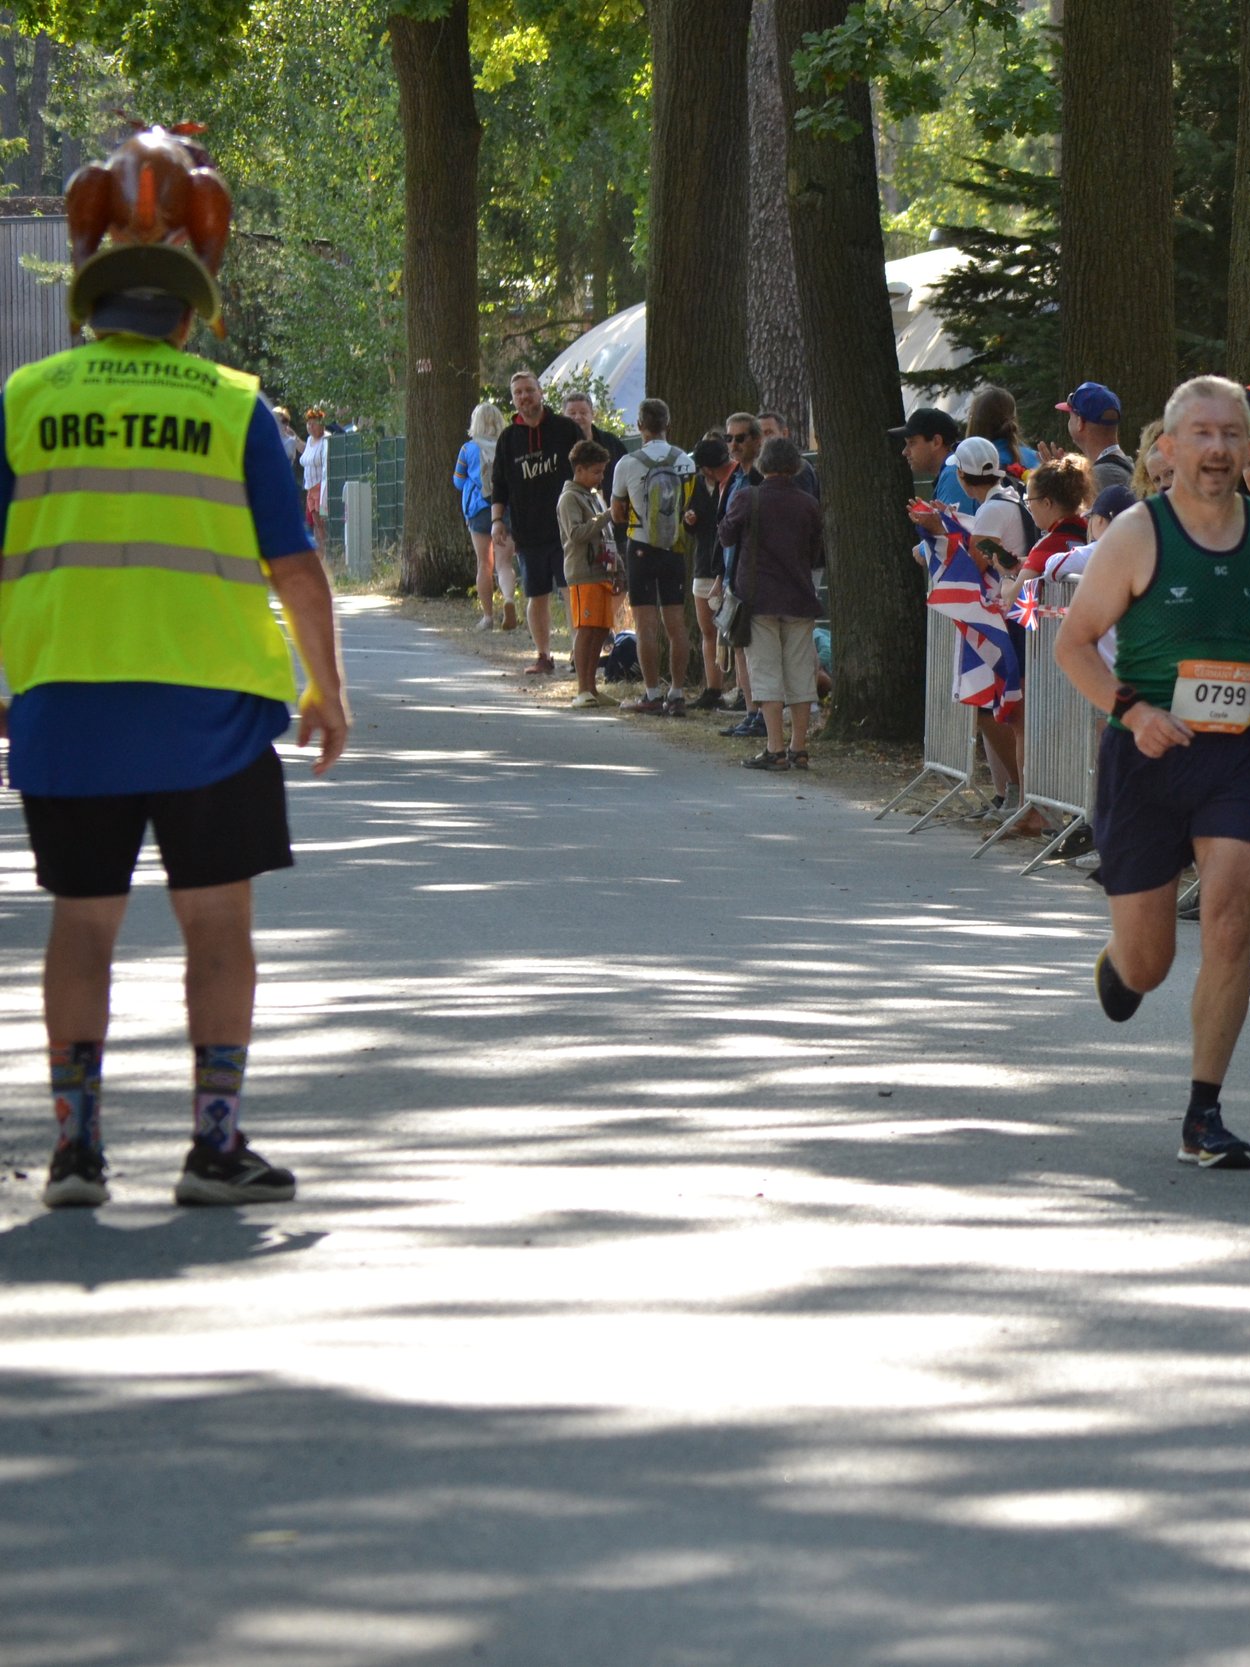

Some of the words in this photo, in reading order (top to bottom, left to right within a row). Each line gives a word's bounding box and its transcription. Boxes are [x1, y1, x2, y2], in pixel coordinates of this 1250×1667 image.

[86, 360, 218, 387] TRIATHLON
[40, 413, 212, 456] ORG-TEAM
[521, 452, 558, 480] Nein!
[1195, 684, 1246, 706] 0799
